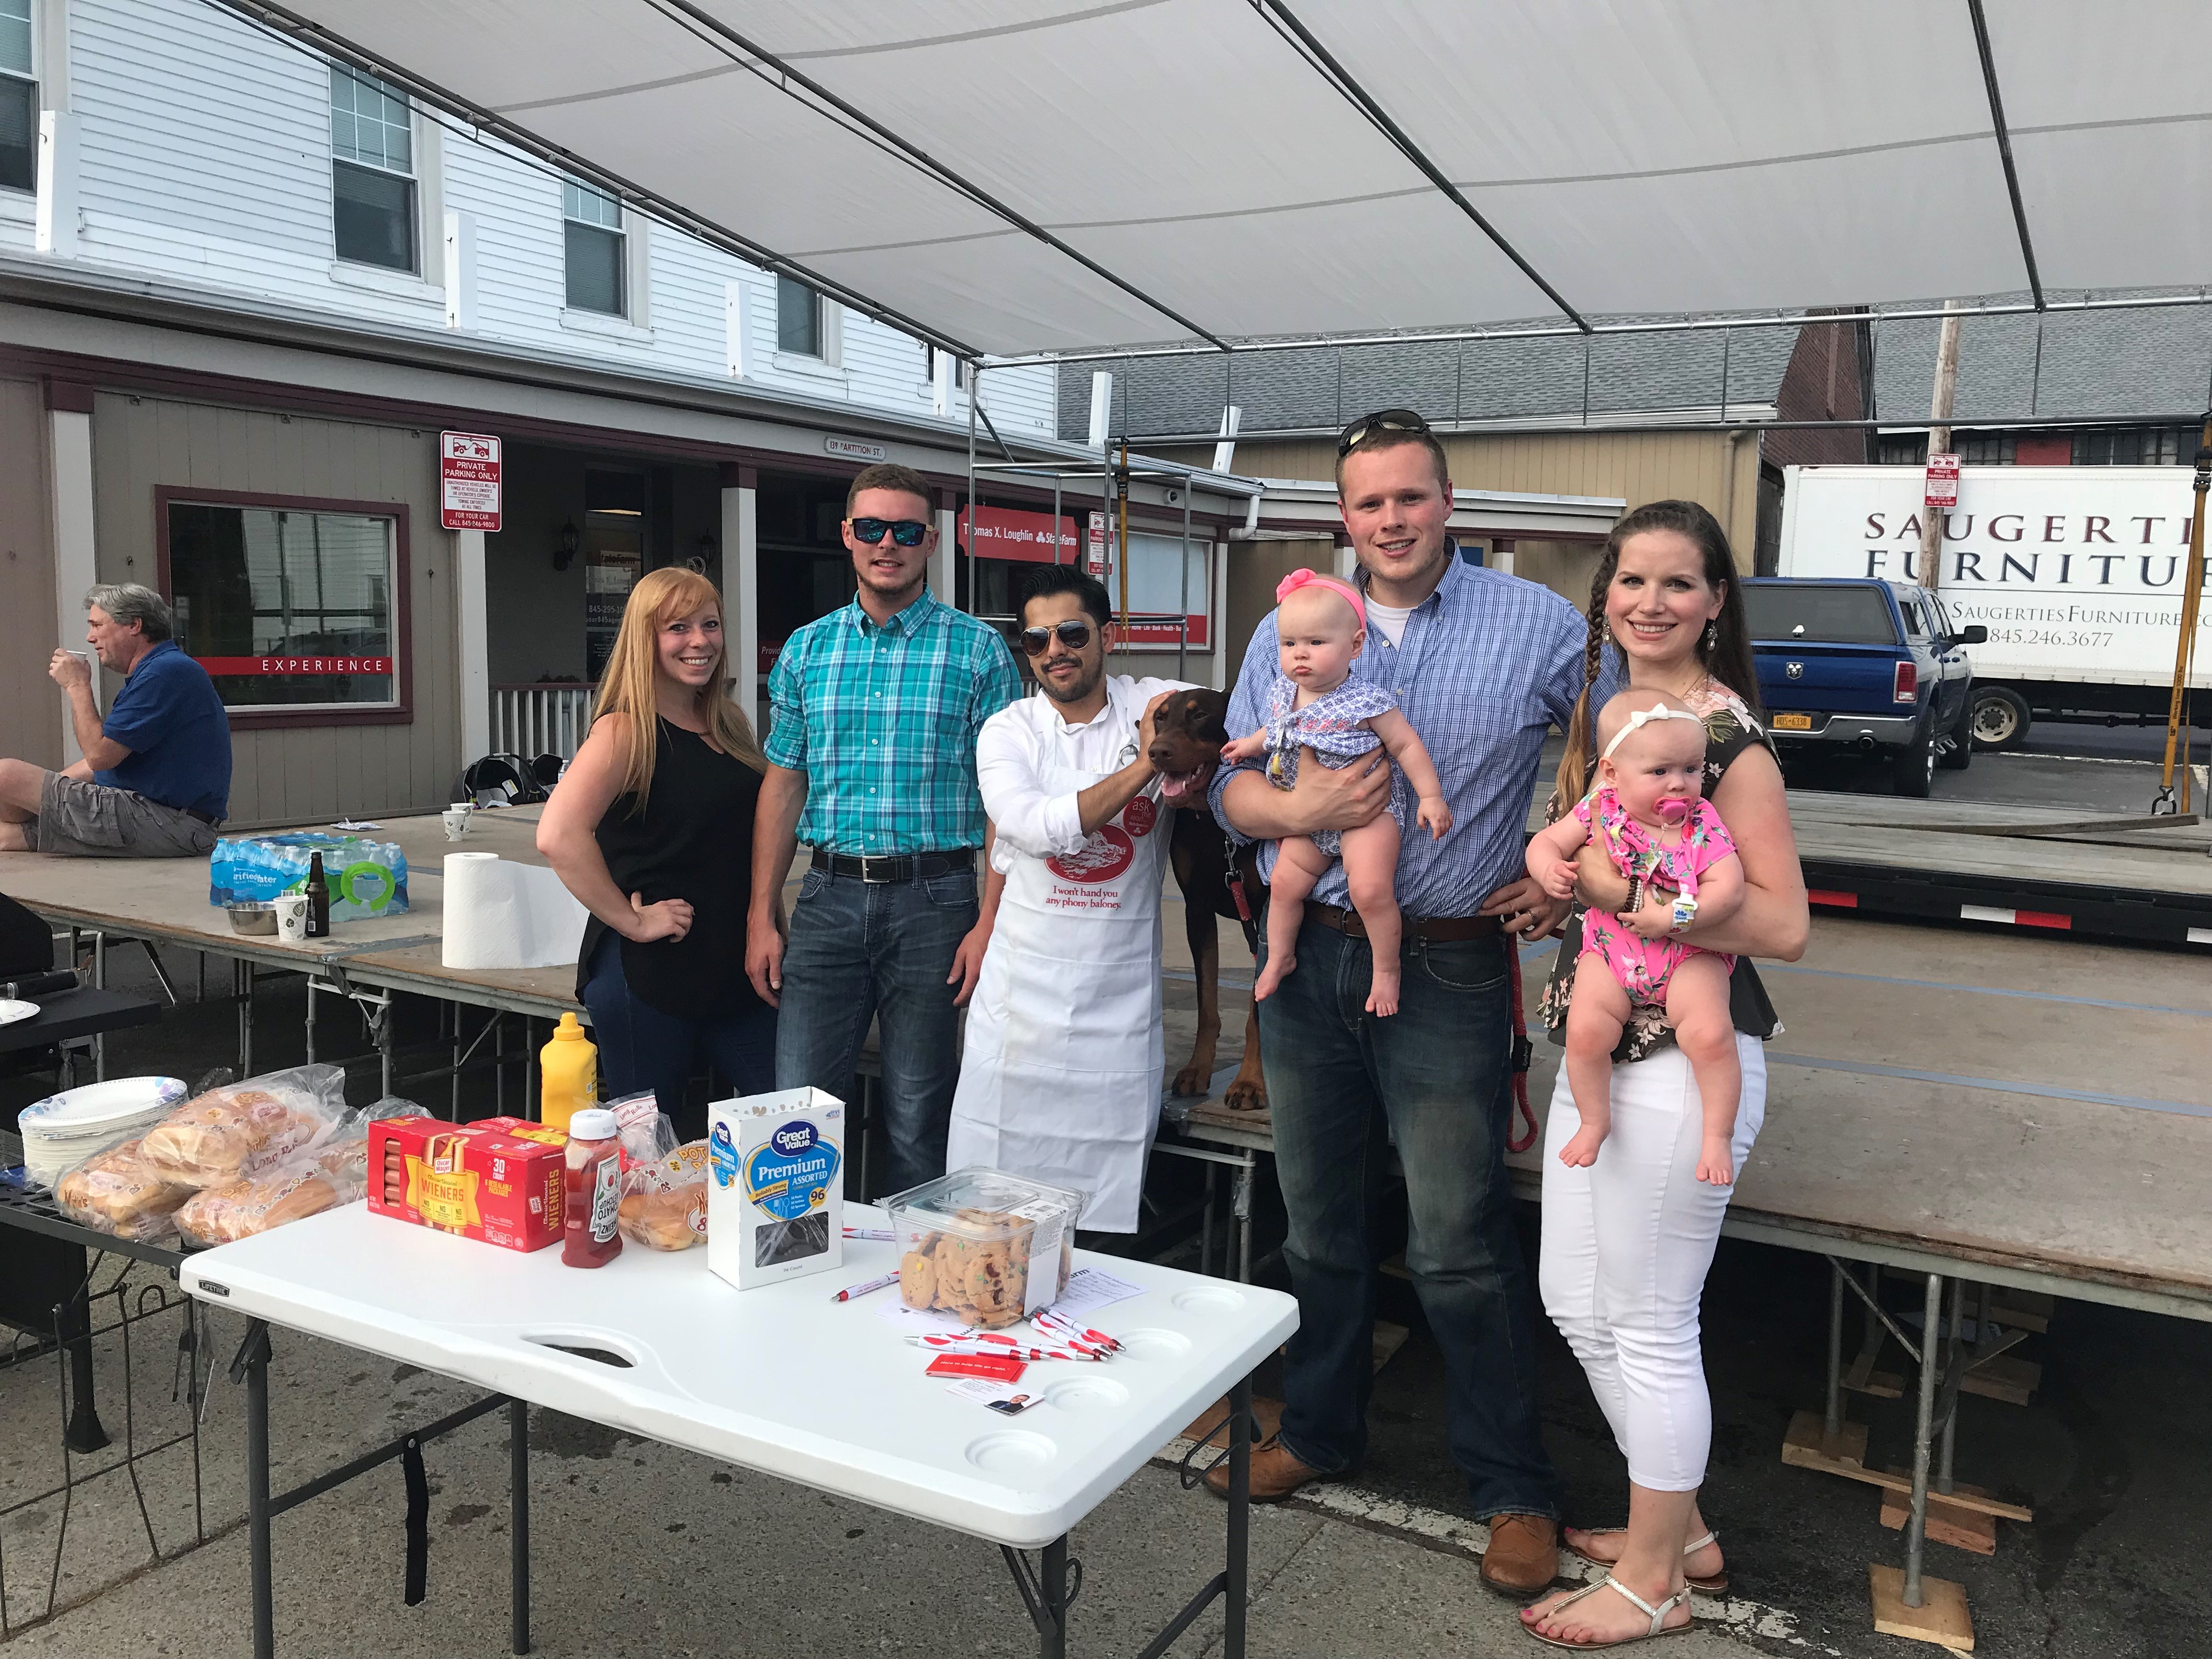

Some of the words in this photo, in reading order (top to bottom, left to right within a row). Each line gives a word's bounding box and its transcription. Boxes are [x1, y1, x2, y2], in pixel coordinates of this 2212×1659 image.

[830, 441, 838, 449] 139
[840, 443, 871, 454] PARTITION
[456, 461, 486, 471] PRIVATE
[445, 469, 476, 478] PARKING
[963, 523, 992, 537] Tomas
[994, 526, 1002, 538] X.
[1004, 527, 1033, 543] Loughlin
[1864, 512, 2194, 545] SAUGERTI
[1046, 532, 1076, 546] StaeFarm
[589, 605, 624, 613] 845-295-10
[1990, 629, 2114, 647] 845.246.3677
[262, 659, 382, 671] EXPERIENCE
[1132, 800, 1150, 812] ask
[1053, 885, 1057, 894] I
[1058, 887, 1079, 896] won't
[1080, 888, 1102, 897] hand
[1103, 891, 1118, 900] you
[1046, 898, 1060, 907] any
[1062, 897, 1088, 910] phony
[1090, 899, 1121, 911] baloney.
[619, 1109, 630, 1120] Long
[630, 1105, 642, 1115] Rolls
[776, 1127, 810, 1144] Great
[785, 1139, 810, 1150] Value
[712, 1141, 735, 1164] Premium
[493, 1158, 505, 1173] 30
[758, 1158, 826, 1181] Premium
[492, 1172, 505, 1181] COUNT
[792, 1170, 828, 1186] ASSORTED
[421, 1178, 464, 1201] WIENERS
[488, 1180, 513, 1192] RESEALABLE
[488, 1186, 509, 1198] PACKAGES
[755, 1188, 772, 1198] Reliably
[772, 1183, 787, 1191] Strong
[549, 1169, 560, 1232] WIENERS
[810, 1189, 825, 1202] 96
[424, 1199, 430, 1207] NO
[601, 1217, 617, 1234] HEINZ
[697, 1217, 707, 1231] 8
